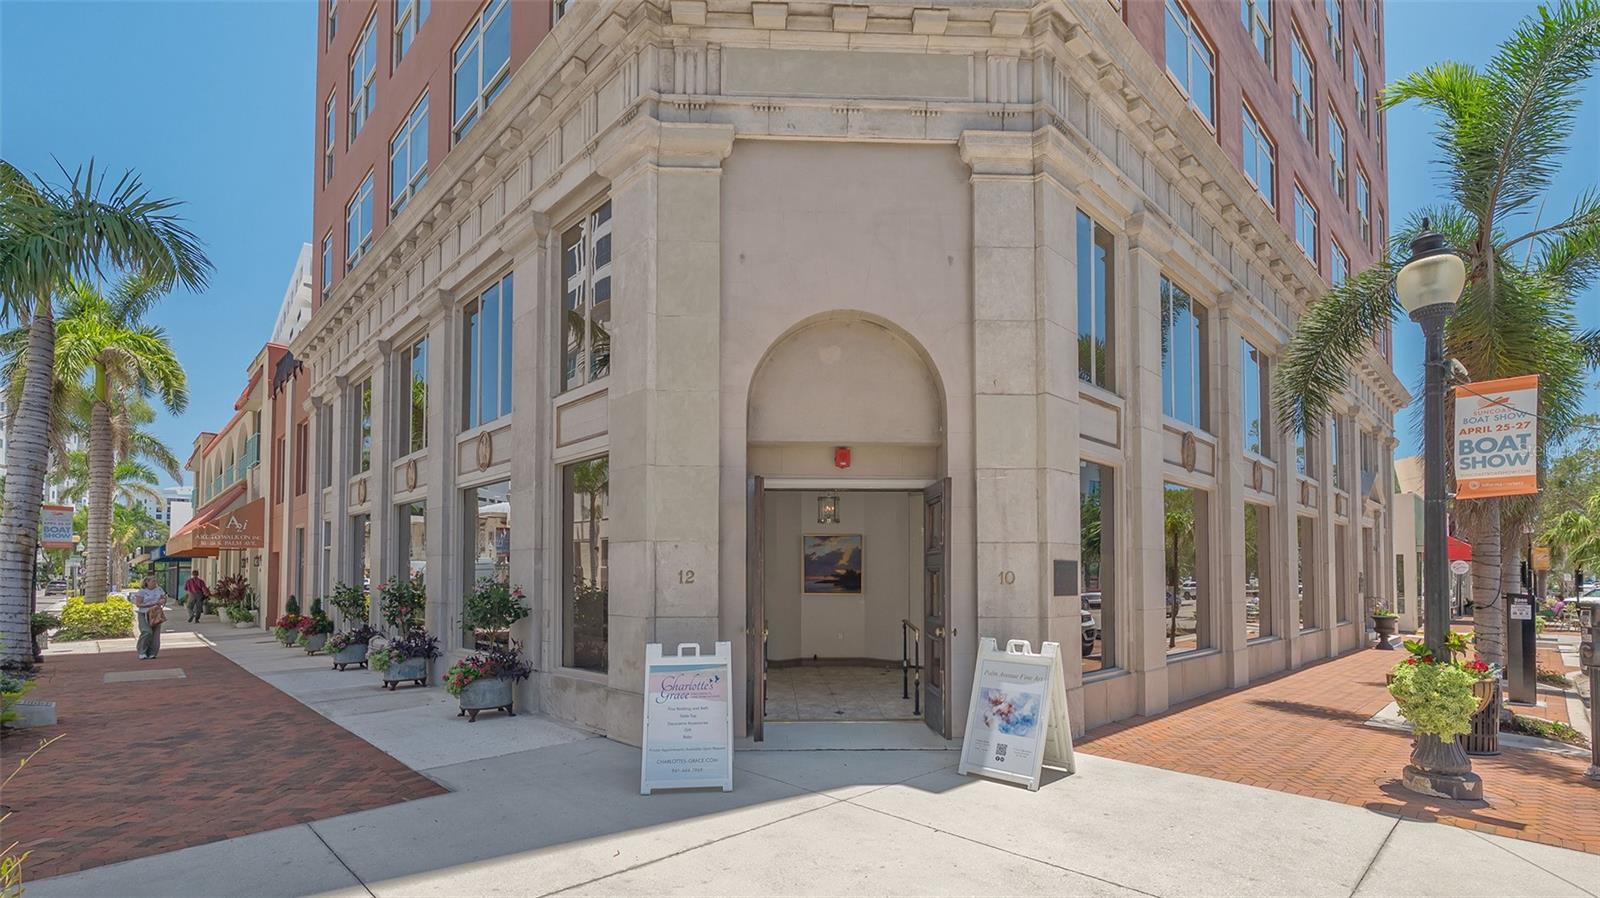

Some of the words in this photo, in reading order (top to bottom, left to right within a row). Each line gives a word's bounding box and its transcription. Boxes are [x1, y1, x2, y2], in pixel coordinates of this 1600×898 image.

[1463, 416, 1489, 425] BOAT
[1494, 411, 1527, 421] SHOW
[1459, 426, 1492, 436] APRIL
[1496, 421, 1531, 432] 25-27
[1458, 433, 1532, 456] BOAT
[1459, 452, 1531, 470] SHOW
[678, 569, 695, 585] 12
[998, 570, 1016, 585] 10
[661, 674, 714, 692] Charlotte's
[656, 689, 690, 704] Grace
